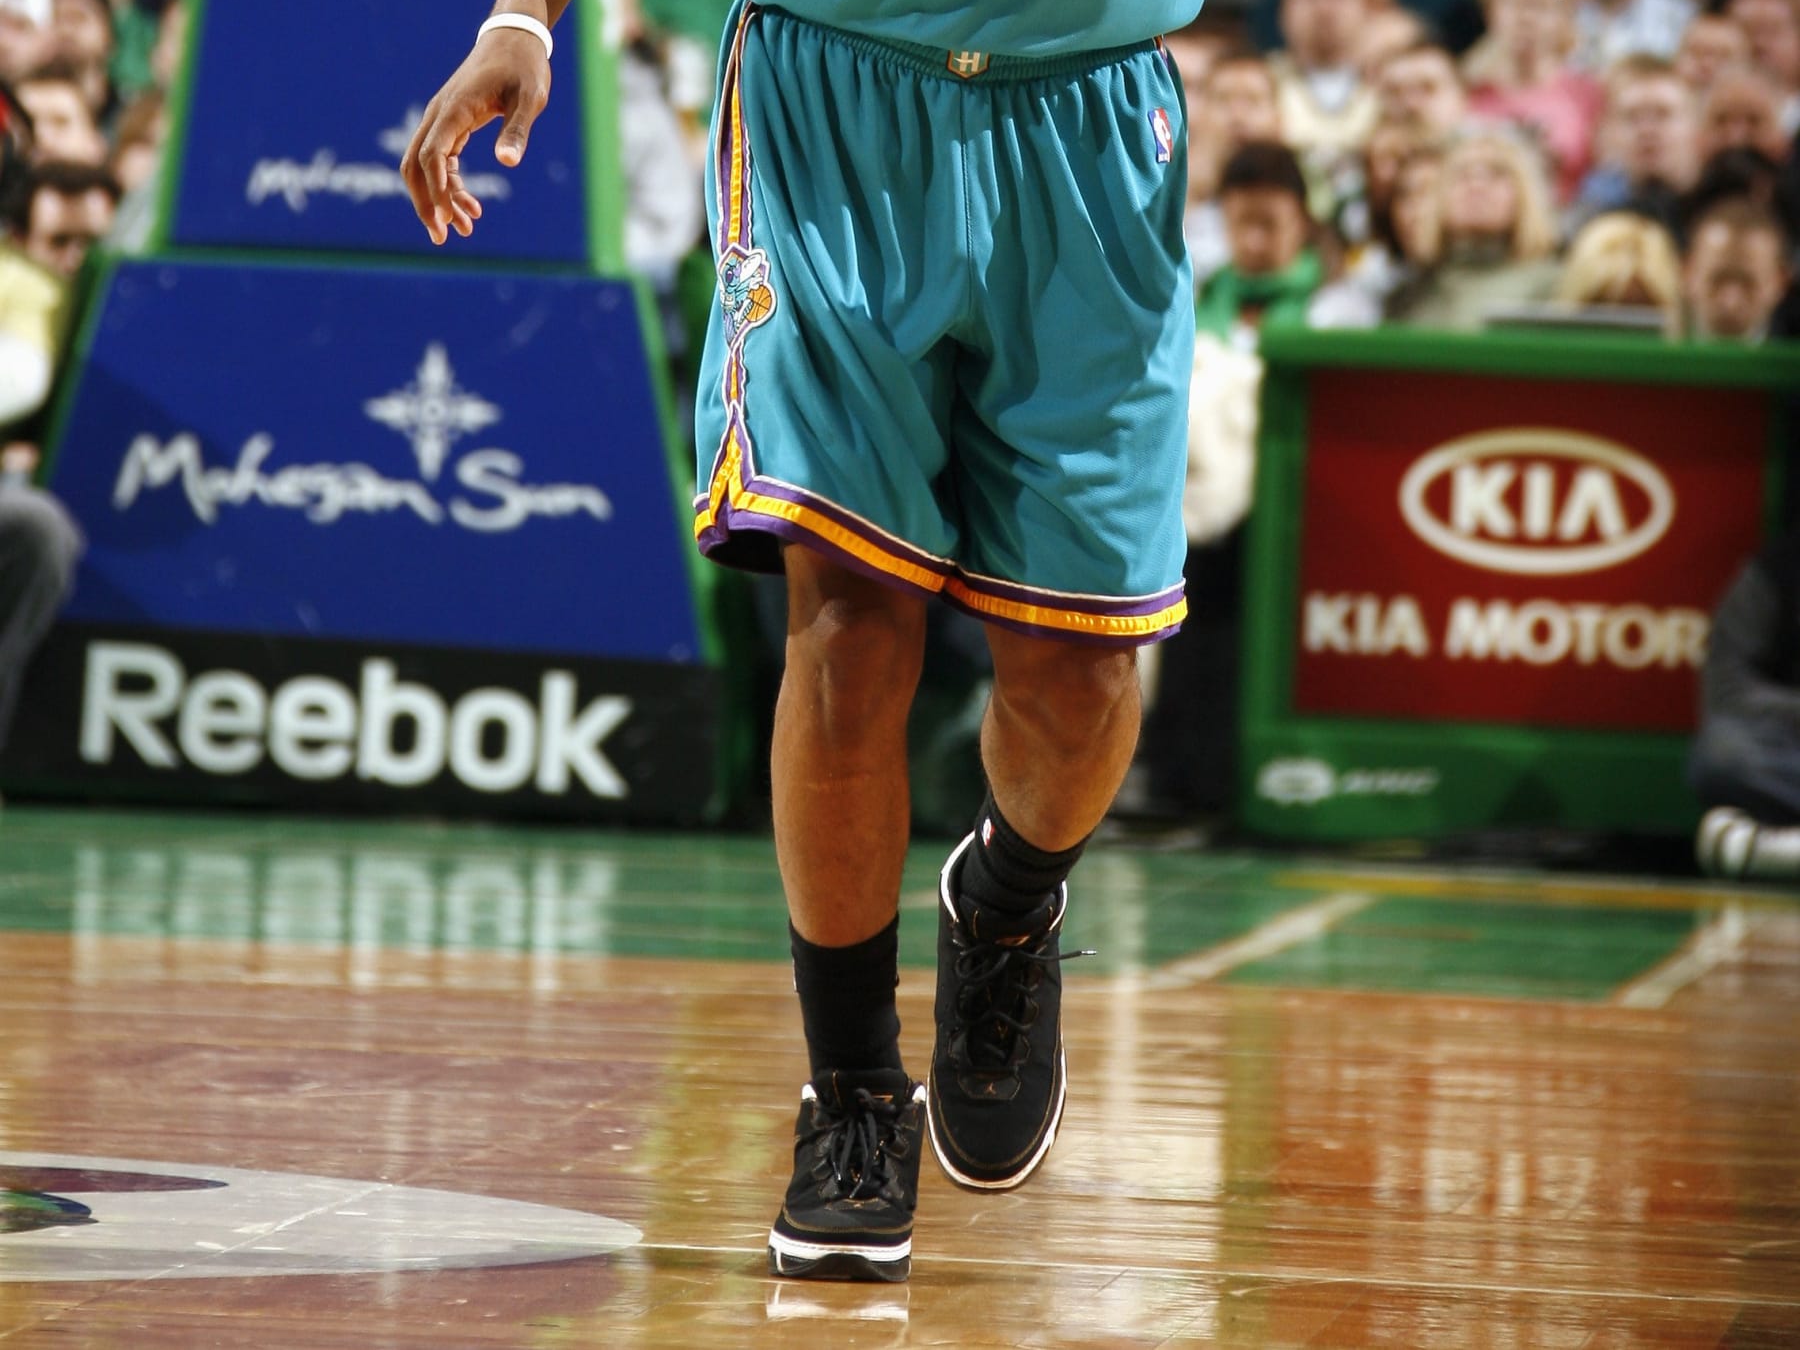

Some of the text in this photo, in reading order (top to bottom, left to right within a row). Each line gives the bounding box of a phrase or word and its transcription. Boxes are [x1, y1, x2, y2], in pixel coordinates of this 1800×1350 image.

[111, 432, 613, 531] Mohegan Sun
[1450, 461, 1628, 541] KIA
[1303, 592, 1428, 658] KIA
[79, 641, 631, 799] Reebok
